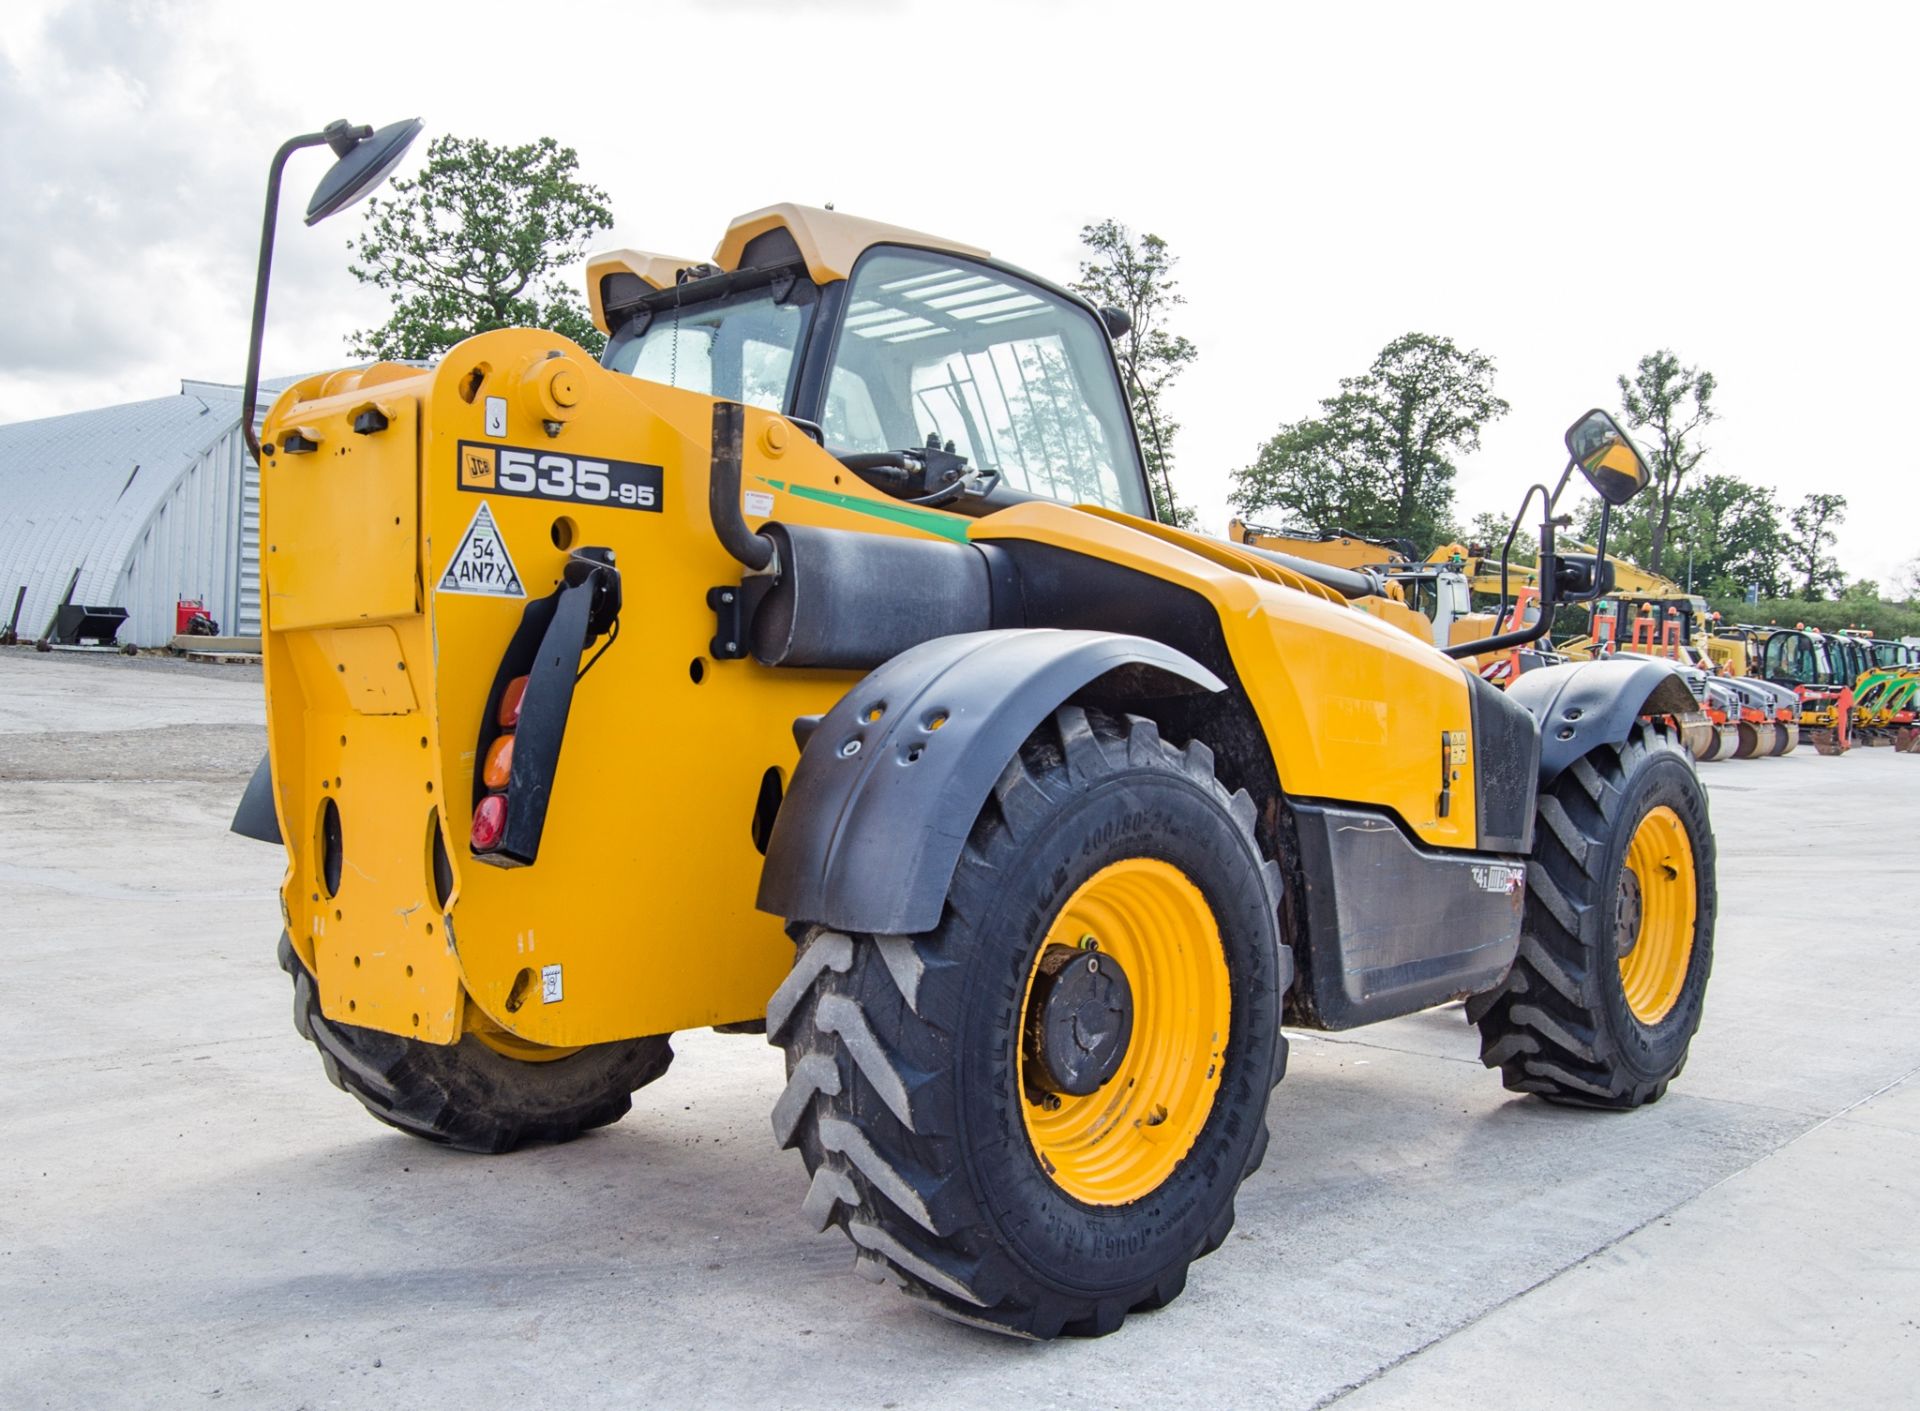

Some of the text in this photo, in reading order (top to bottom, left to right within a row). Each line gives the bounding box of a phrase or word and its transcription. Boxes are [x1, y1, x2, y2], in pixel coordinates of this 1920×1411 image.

[469, 454, 491, 476] JCB
[473, 538, 495, 560] 54
[460, 560, 506, 585] AN7X
